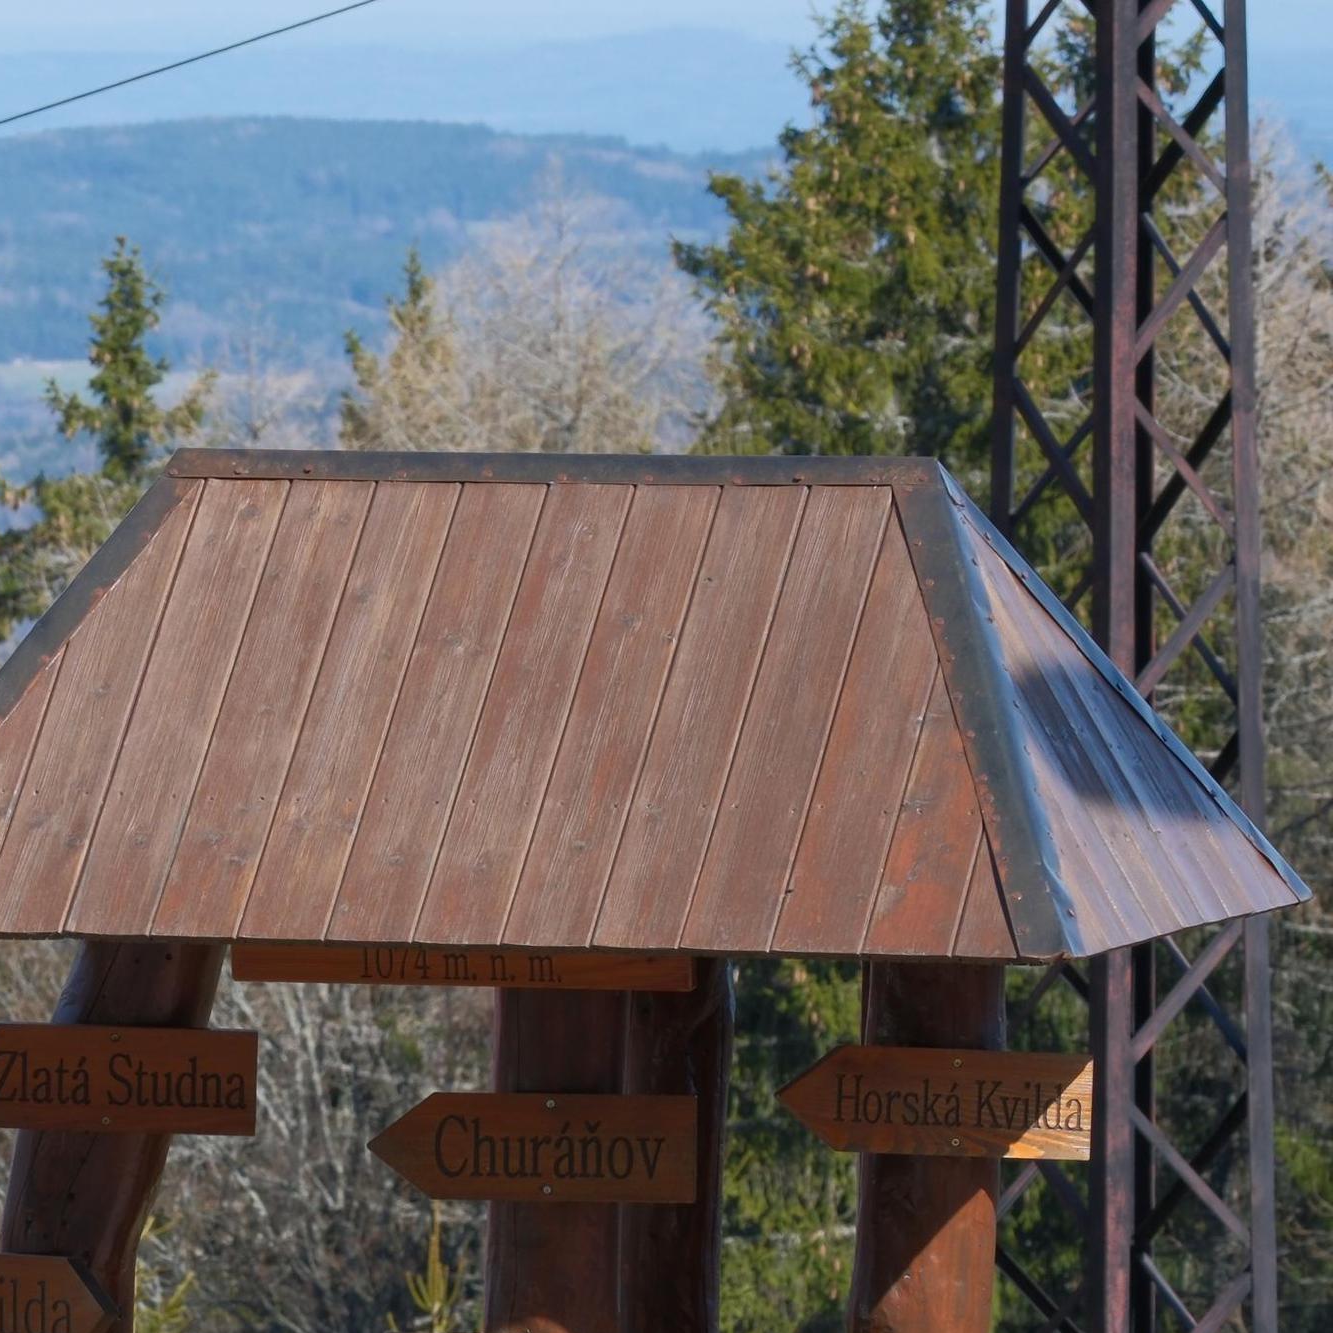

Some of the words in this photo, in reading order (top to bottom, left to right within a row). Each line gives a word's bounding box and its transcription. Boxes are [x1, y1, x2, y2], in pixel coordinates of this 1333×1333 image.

[443, 952, 477, 981] m.
[490, 953, 516, 982] n.
[528, 954, 562, 983] m.
[107, 1053, 247, 1110] Studna
[835, 1073, 962, 1128] Horská
[974, 1079, 1083, 1131] Kvilda
[434, 1114, 665, 1180] Churáňov
